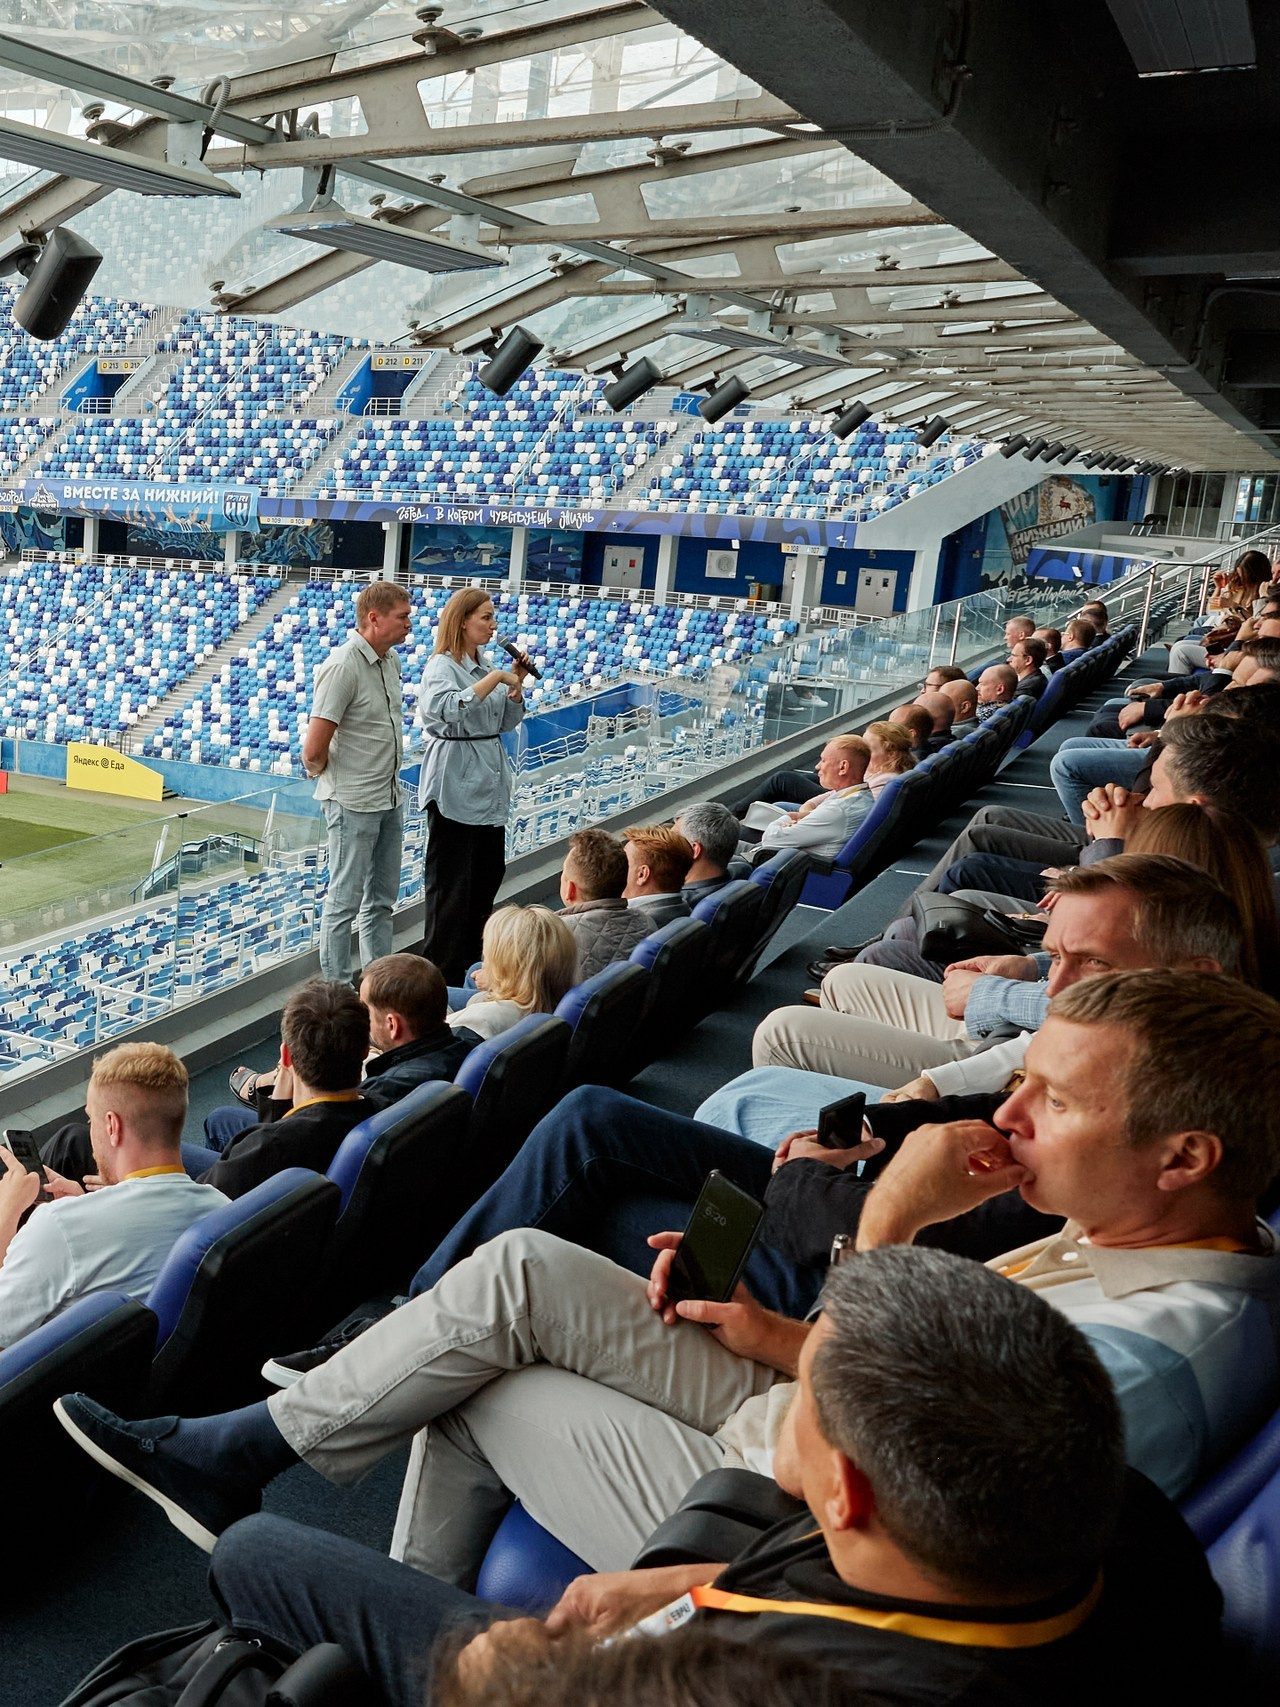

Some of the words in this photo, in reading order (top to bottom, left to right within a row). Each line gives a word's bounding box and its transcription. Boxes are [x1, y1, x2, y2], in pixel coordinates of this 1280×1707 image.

[63, 485, 118, 500] ВМЕСТЕ
[121, 487, 140, 501] ЗА
[145, 487, 219, 504] НИЖНИЙ!
[433, 506, 444, 520] В
[1015, 514, 1087, 545] НИЖНИЙ
[73, 755, 99, 767] Яндекс
[110, 761, 125, 770] Еда
[704, 1206, 727, 1226] 6:20
